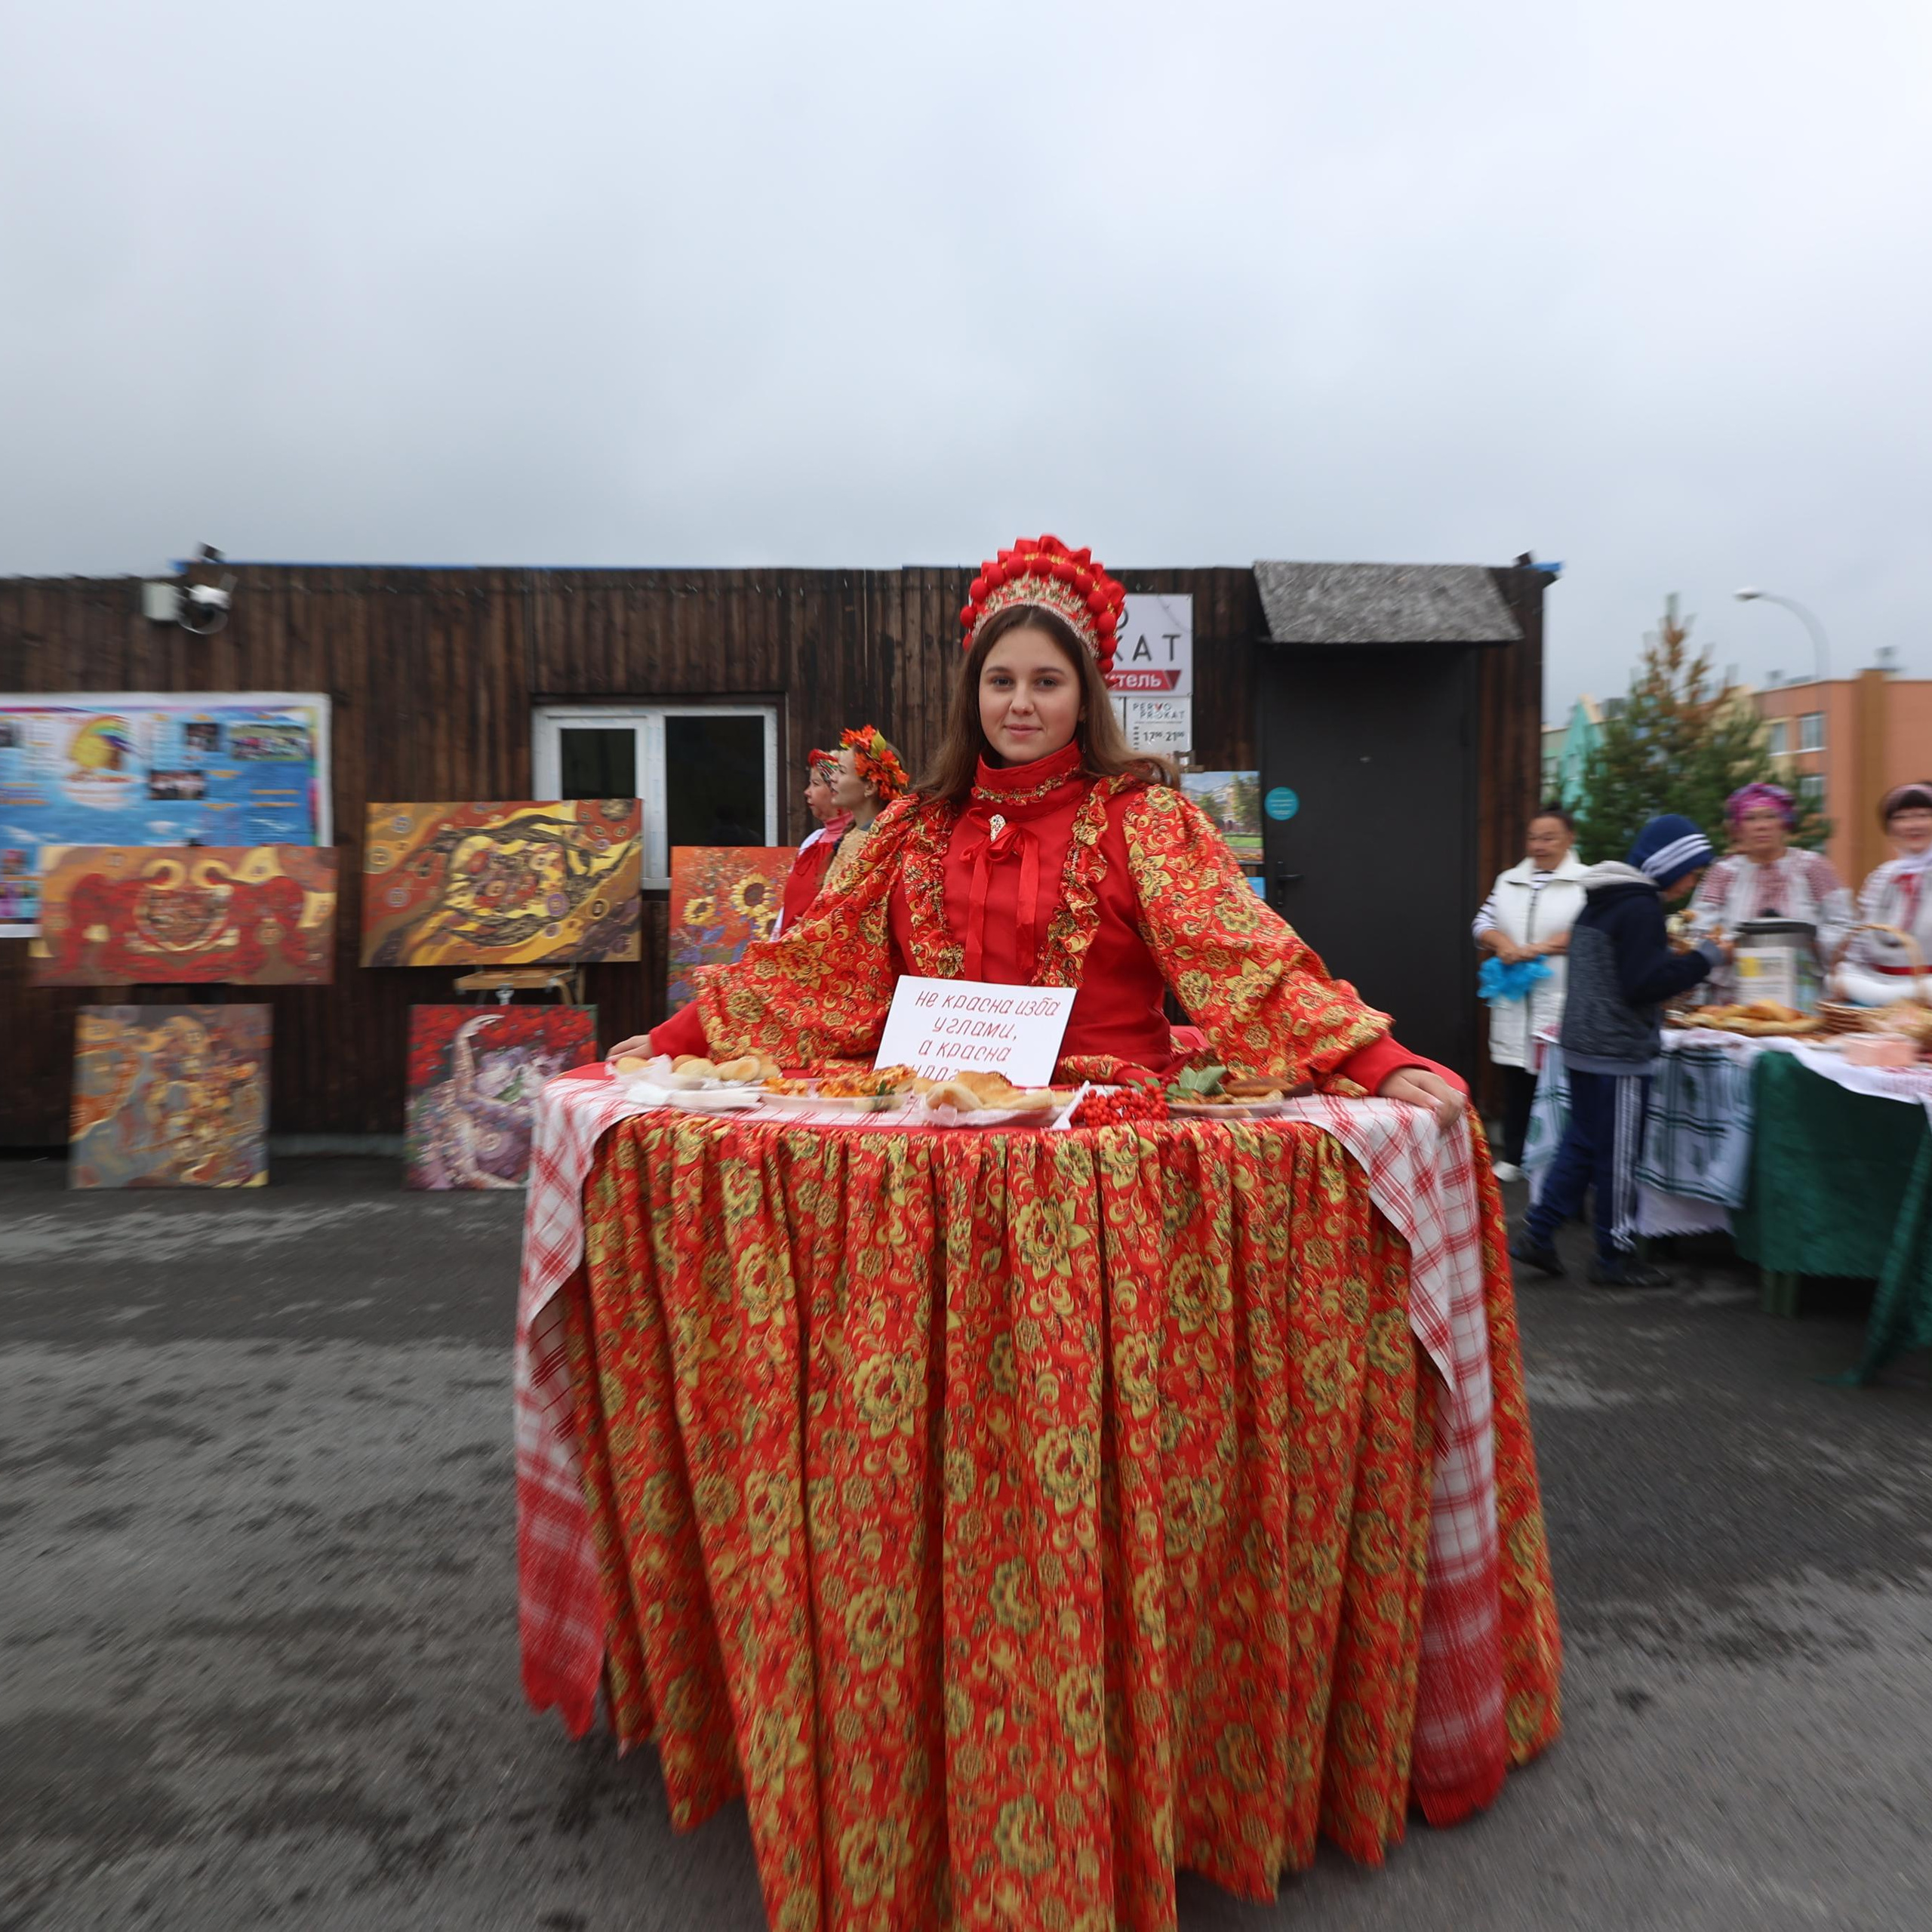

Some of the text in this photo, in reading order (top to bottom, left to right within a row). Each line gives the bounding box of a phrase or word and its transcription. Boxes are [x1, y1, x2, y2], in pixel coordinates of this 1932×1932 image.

[942, 995, 1014, 1014] красна
[1015, 997, 1060, 1016] изба
[932, 1017, 1017, 1041] углами,
[918, 1039, 1012, 1062] а красна
